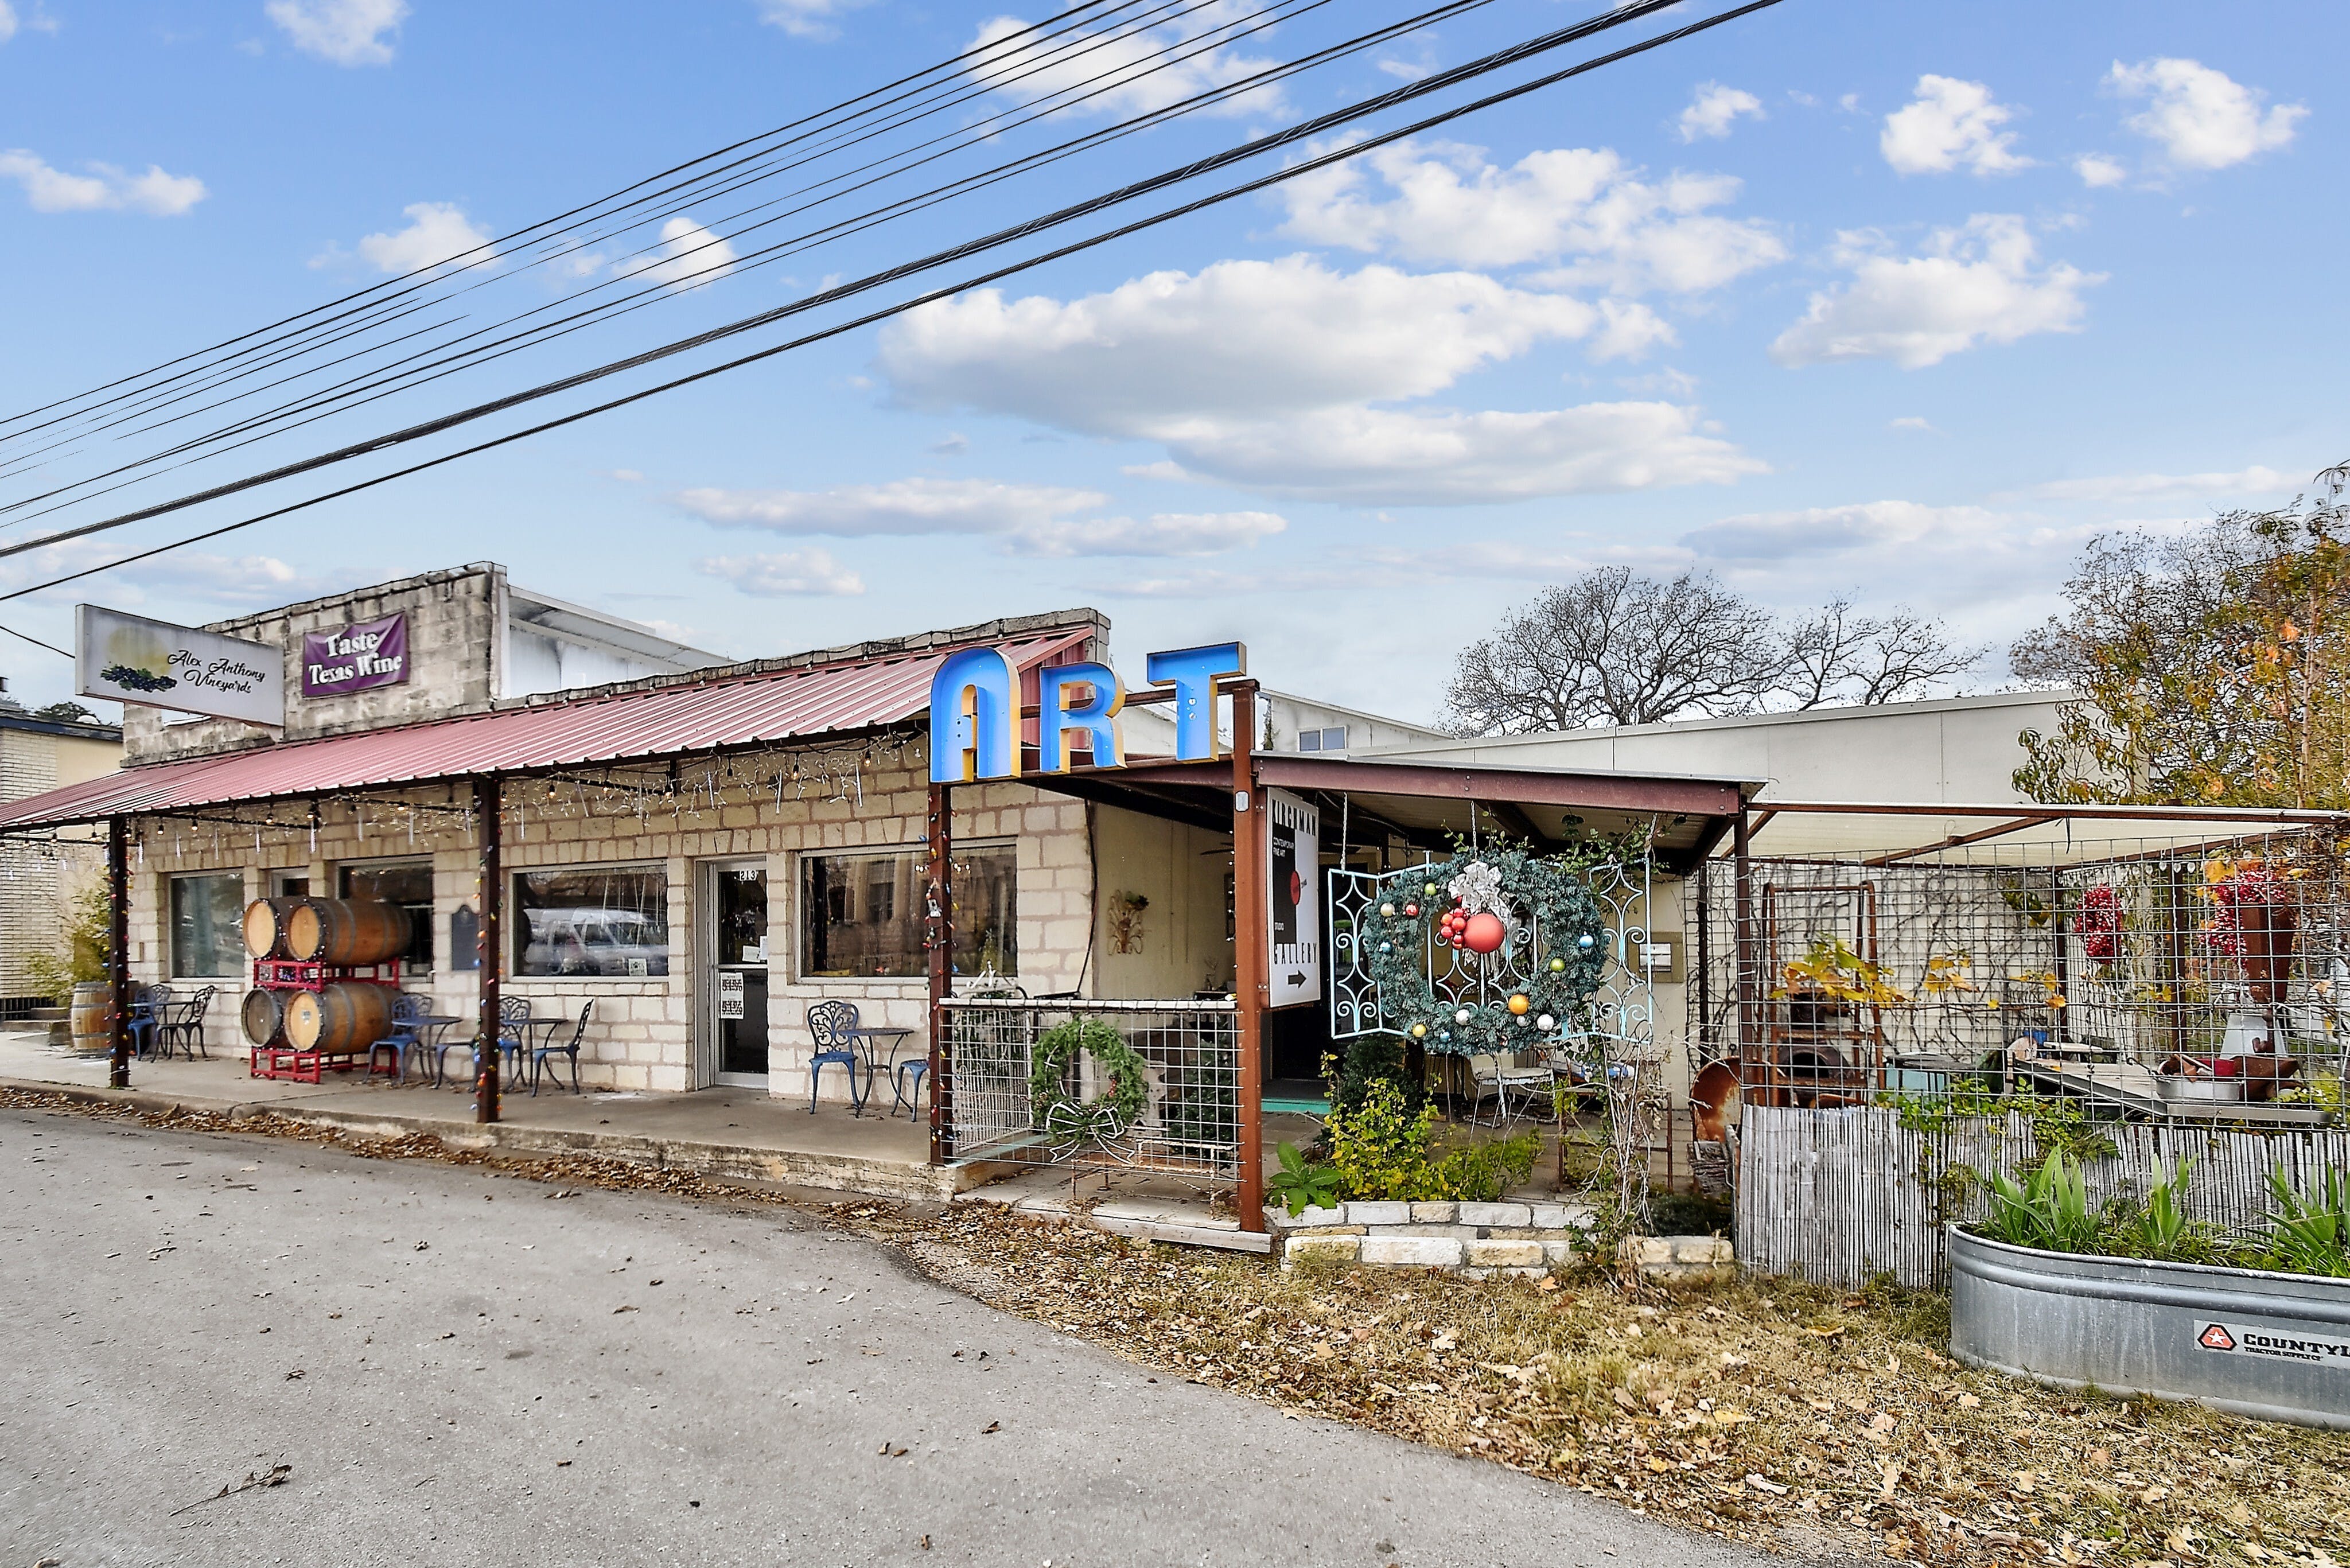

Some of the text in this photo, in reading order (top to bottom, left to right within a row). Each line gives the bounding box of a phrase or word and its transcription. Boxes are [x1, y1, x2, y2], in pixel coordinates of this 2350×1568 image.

[326, 632, 379, 657] Taste
[168, 650, 266, 682] Alex Anthony
[308, 651, 403, 685] Texas Wine
[184, 669, 252, 693] Vineyards
[930, 641, 1247, 783] ART
[1272, 799, 1317, 836] KIRCHMAN
[740, 870, 755, 880] 213
[1274, 942, 1317, 964] GALLERY
[2244, 1347, 2281, 1356] TRACTOR
[2282, 1351, 2310, 1360] SUPPLY
